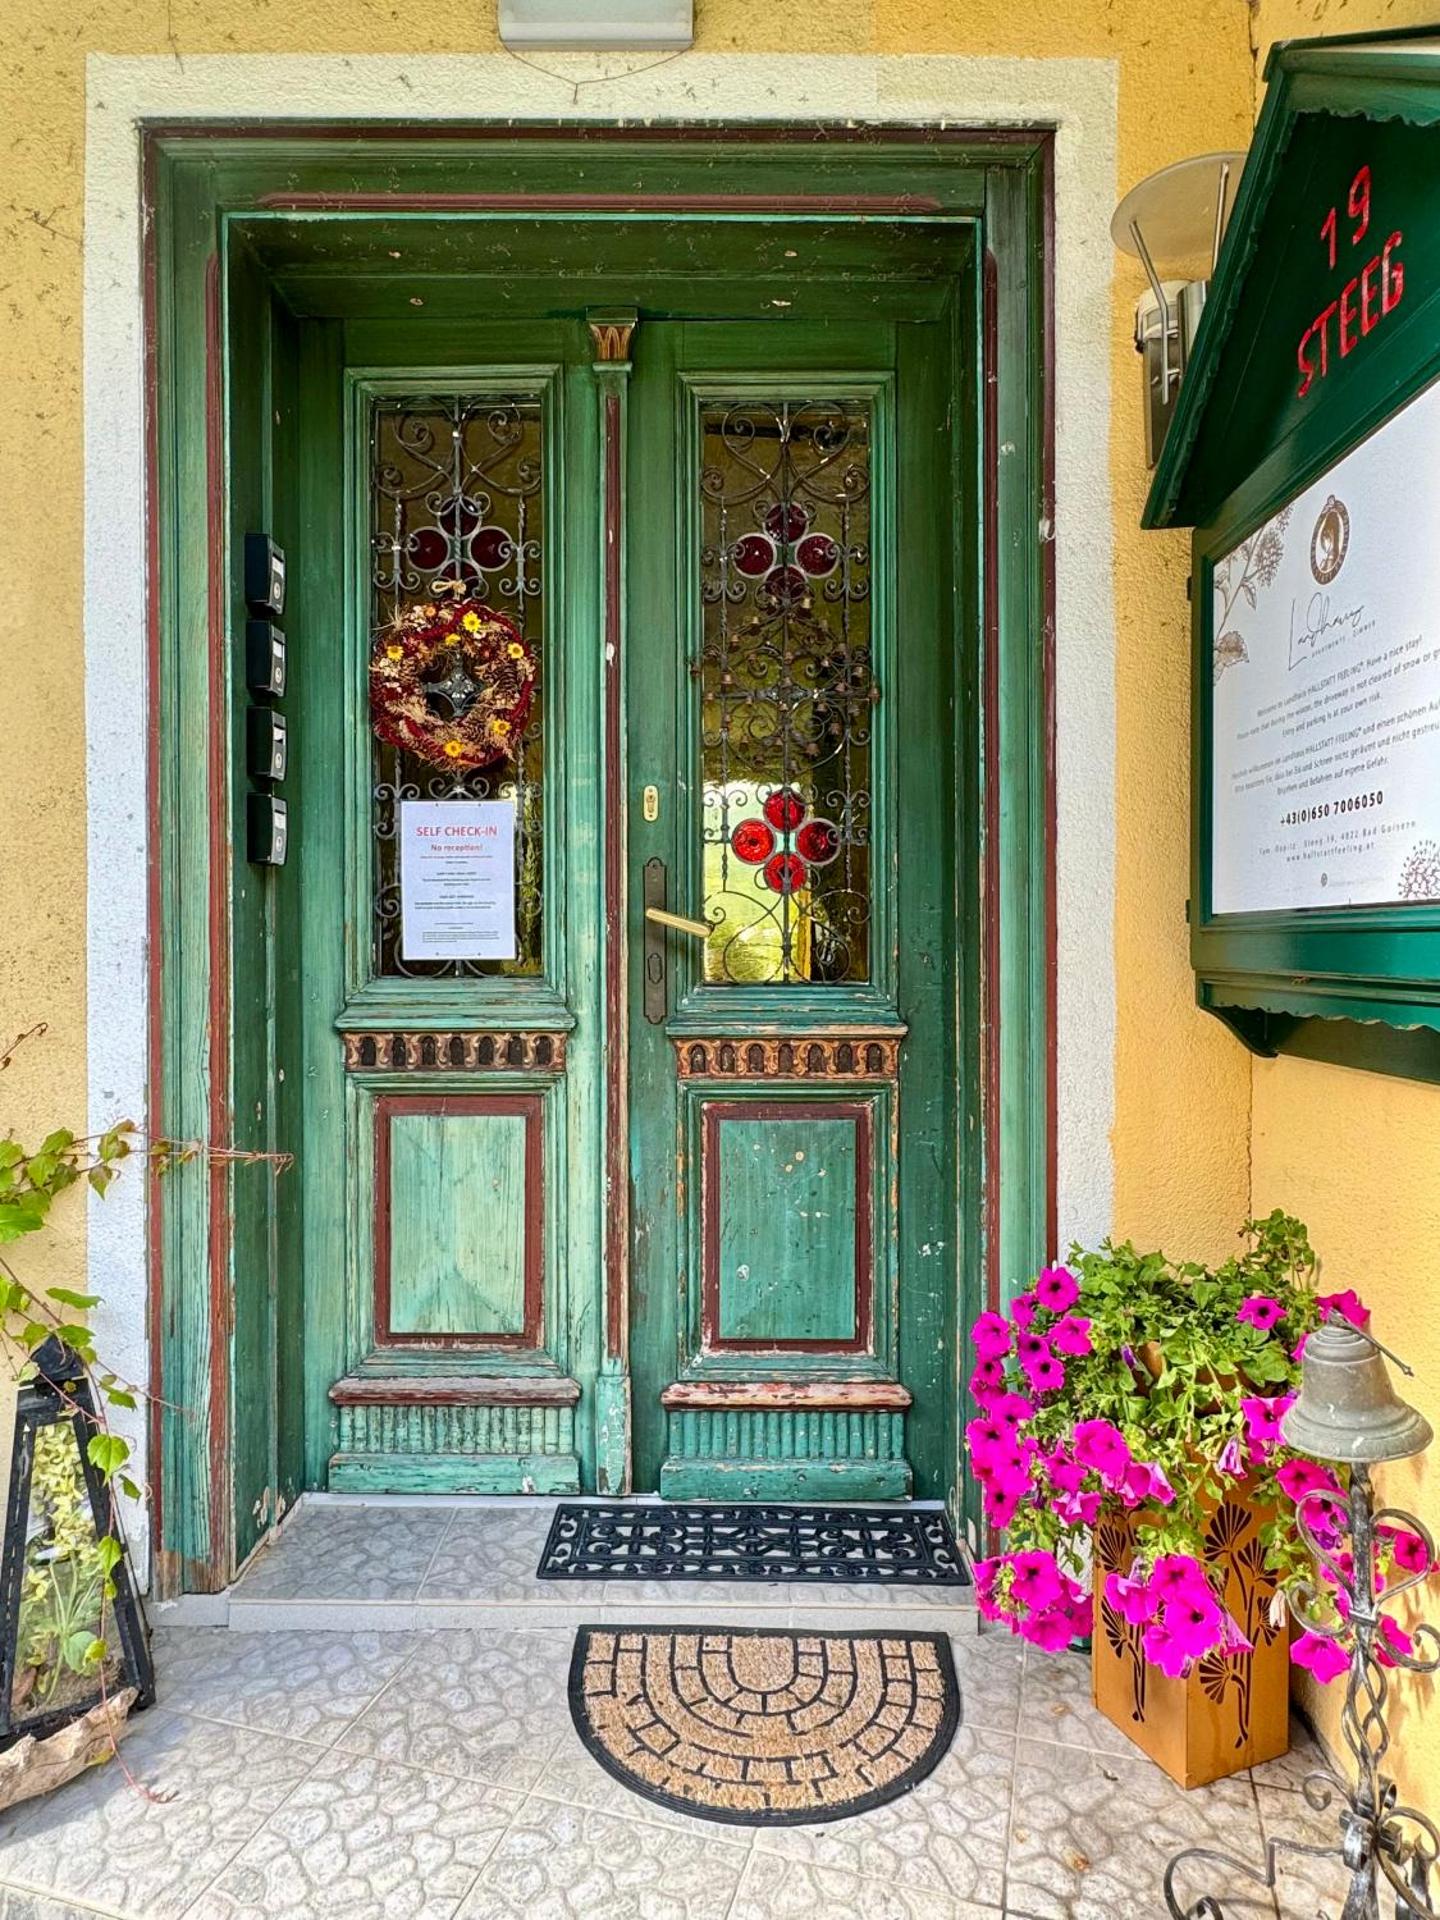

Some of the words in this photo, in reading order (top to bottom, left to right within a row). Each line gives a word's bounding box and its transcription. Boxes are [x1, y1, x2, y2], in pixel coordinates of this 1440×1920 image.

[1320, 164, 1372, 270] 19
[1297, 229, 1405, 398] STEEG
[1389, 645, 1404, 657] nice
[1356, 679, 1367, 690] not
[1368, 668, 1392, 686] cleared
[1394, 661, 1401, 676] of
[1402, 657, 1420, 672] snow
[1423, 652, 1431, 663] or
[1362, 721, 1375, 735] und
[1377, 735, 1391, 748] und
[1392, 729, 1410, 744] nicht
[1280, 803, 1330, 826] +43(0)650
[1333, 790, 1384, 815] 7006050
[416, 826, 441, 837] SELF
[444, 826, 498, 837] CHECK-IN
[1362, 826, 1377, 838] Bad
[1380, 821, 1416, 834] Goisern
